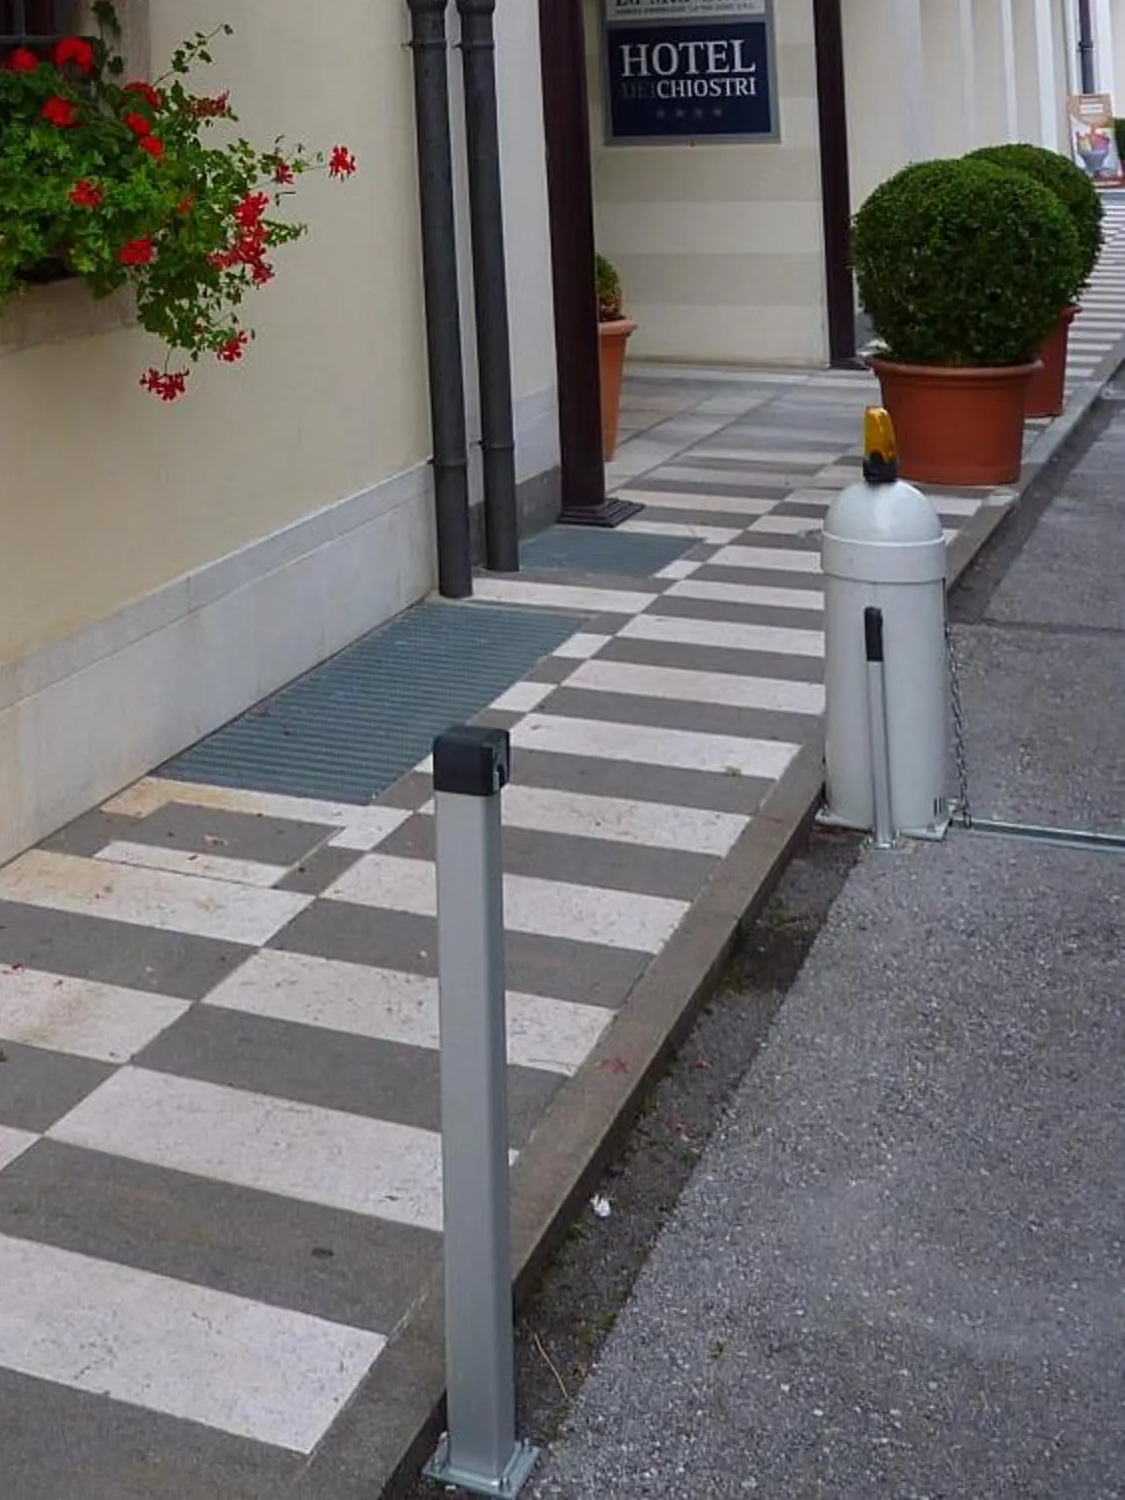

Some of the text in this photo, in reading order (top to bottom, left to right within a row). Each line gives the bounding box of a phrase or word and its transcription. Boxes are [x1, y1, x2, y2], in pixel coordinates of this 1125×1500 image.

[620, 40, 756, 77] HOTEL
[621, 77, 757, 99] DEI CHIOSTRI
